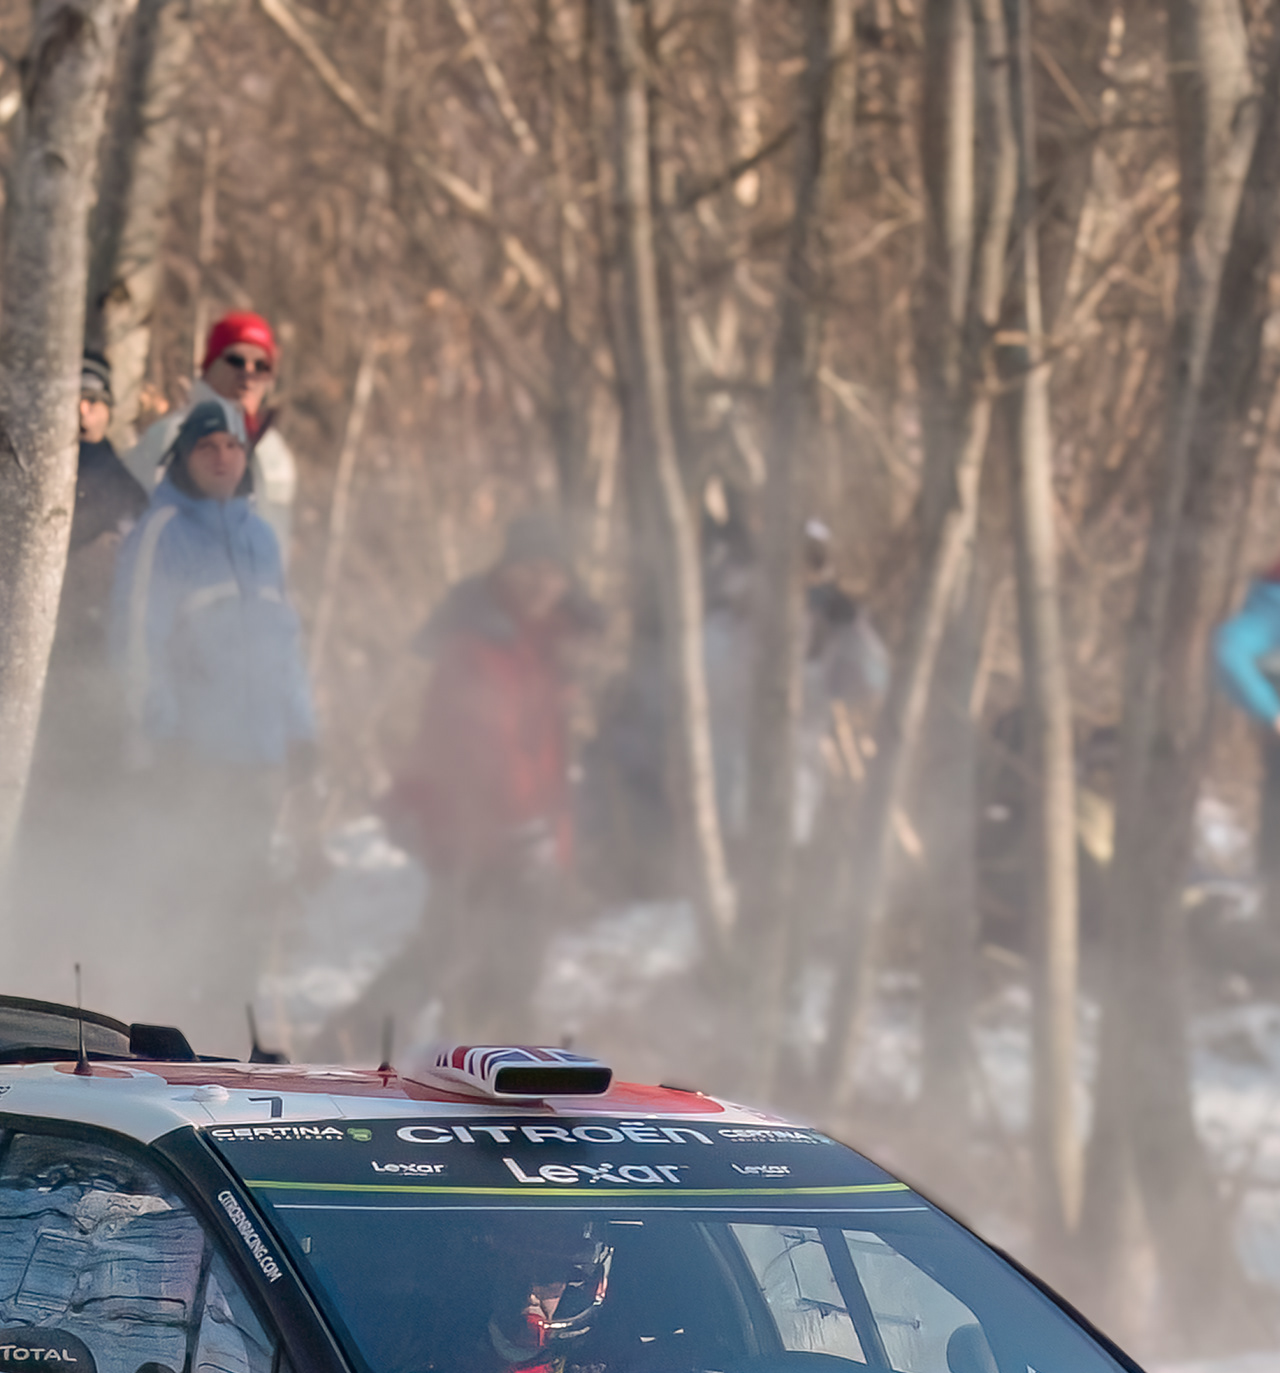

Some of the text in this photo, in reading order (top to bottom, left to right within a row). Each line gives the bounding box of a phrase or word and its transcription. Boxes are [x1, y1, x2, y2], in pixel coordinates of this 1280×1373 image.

[248, 1096, 283, 1118] 7
[211, 1126, 345, 1138] CERTINA
[503, 1157, 681, 1184] Lexar
